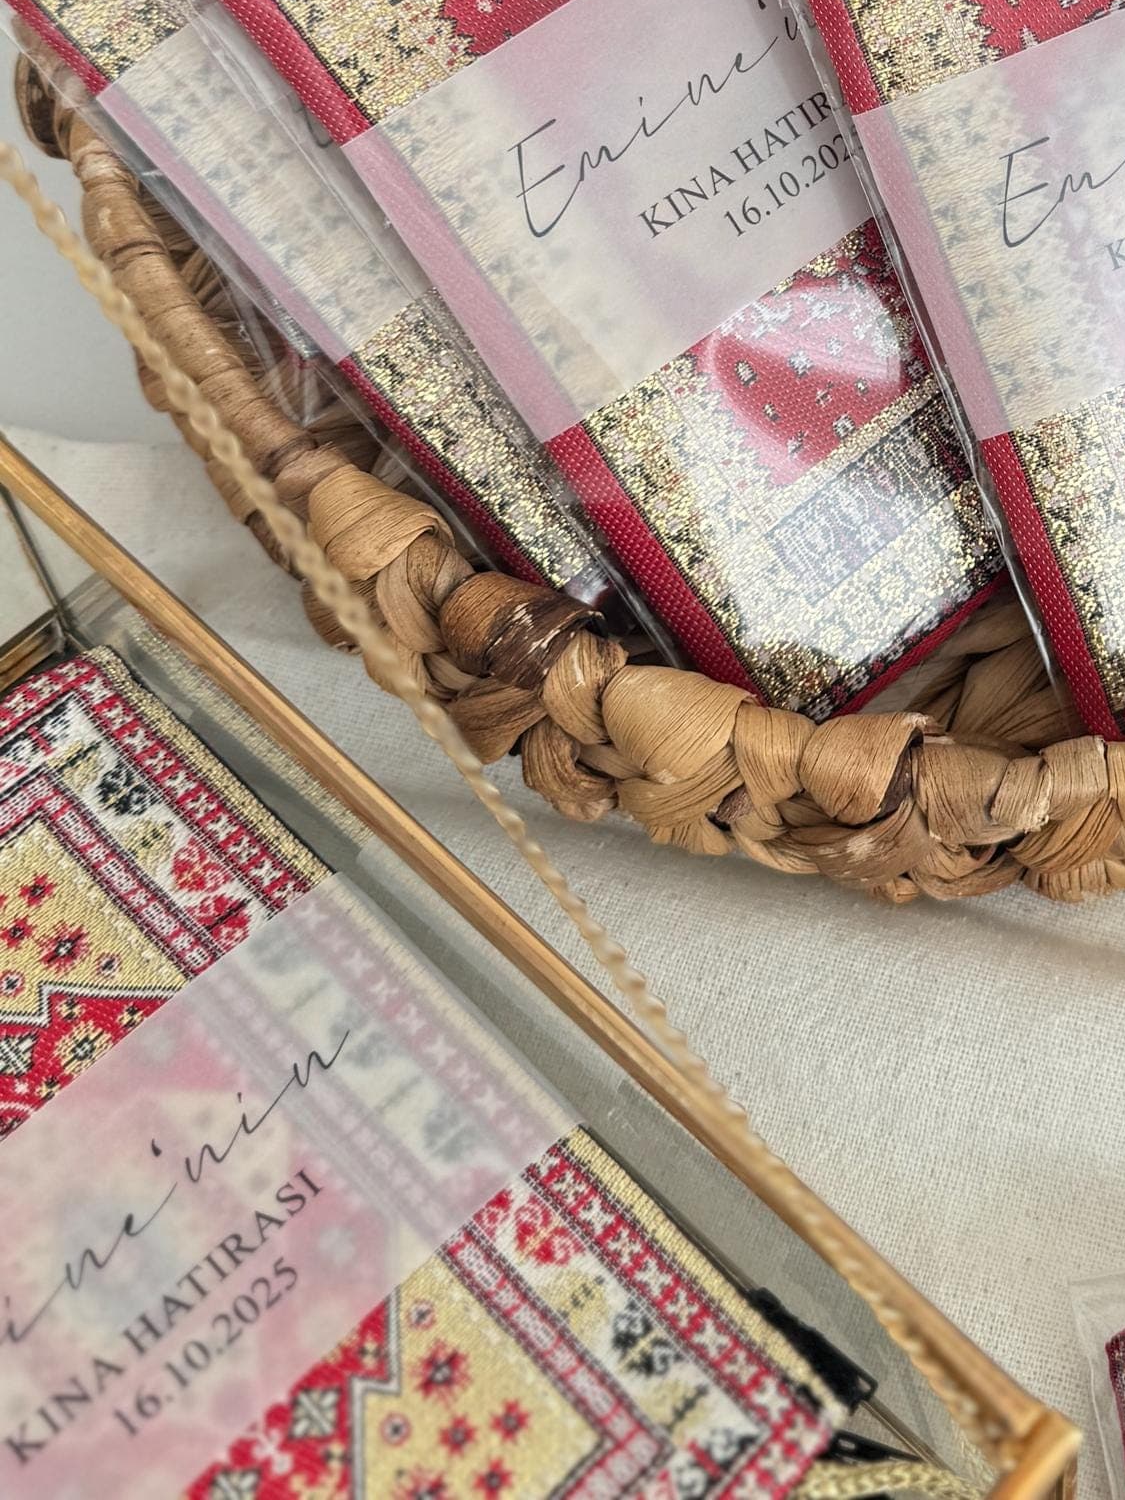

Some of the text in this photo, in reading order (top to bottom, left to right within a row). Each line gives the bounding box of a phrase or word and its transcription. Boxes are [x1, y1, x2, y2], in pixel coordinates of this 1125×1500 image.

[638, 91, 845, 239] KINA HATIR
[723, 124, 863, 237] 16.10.202
[113, 1256, 300, 1438] 16.10.2025
